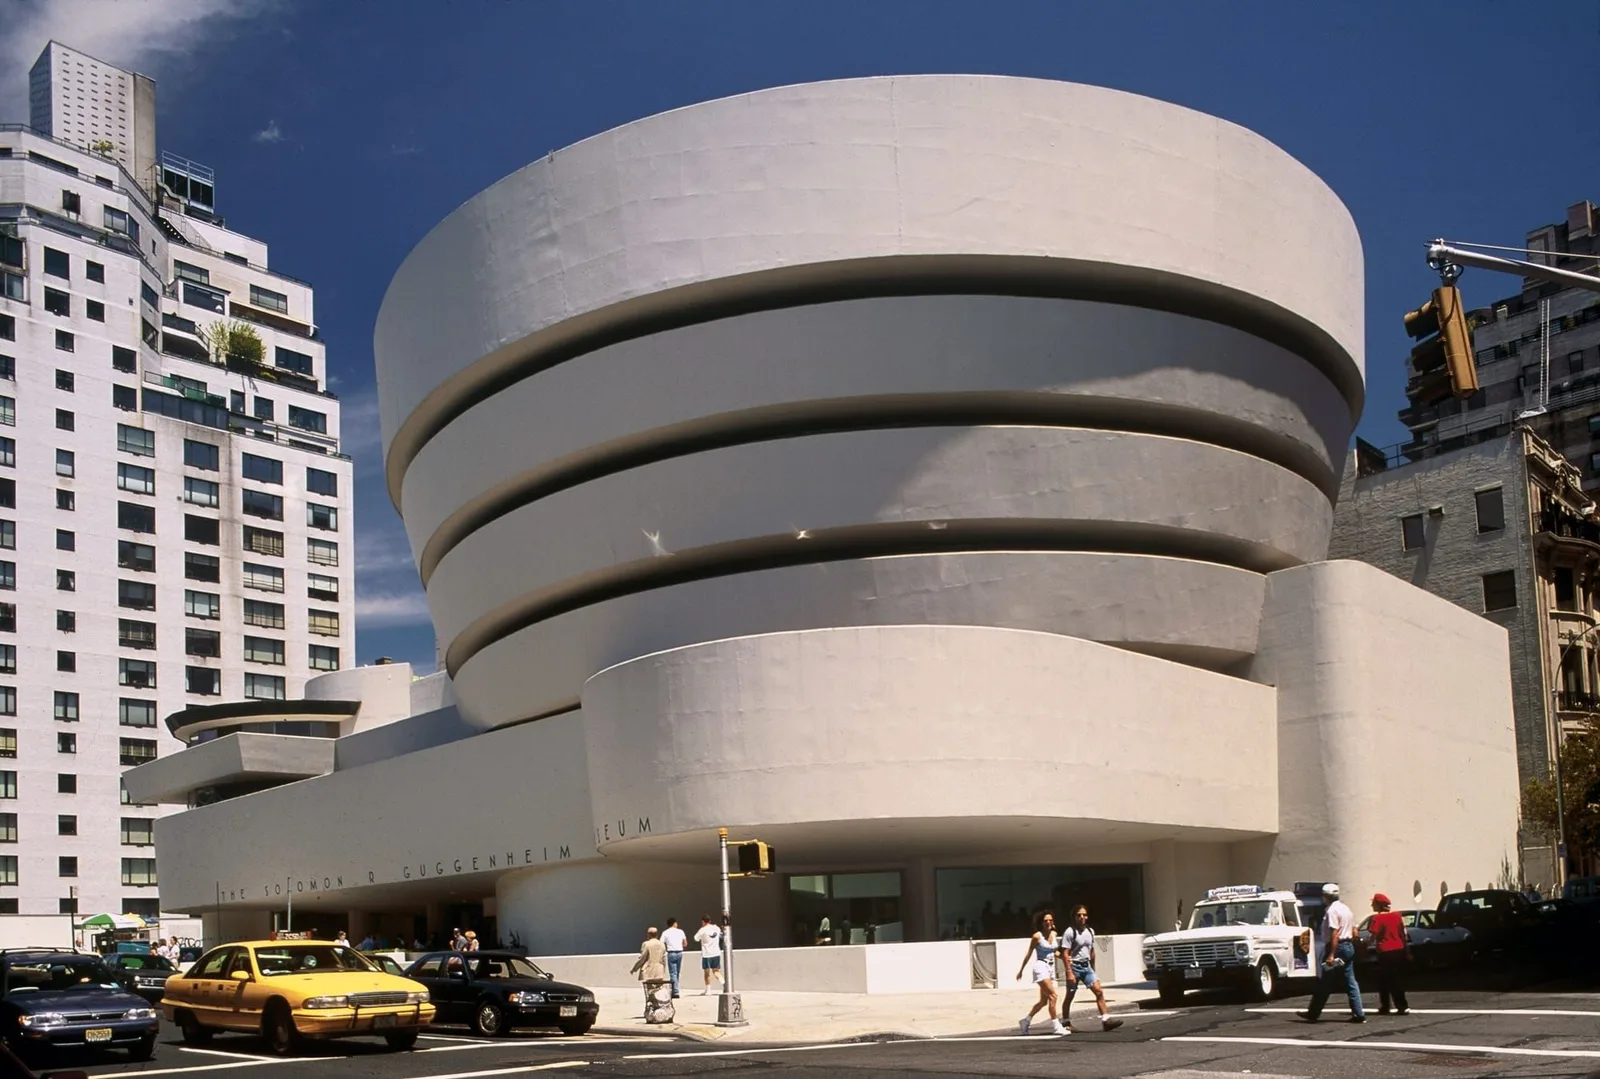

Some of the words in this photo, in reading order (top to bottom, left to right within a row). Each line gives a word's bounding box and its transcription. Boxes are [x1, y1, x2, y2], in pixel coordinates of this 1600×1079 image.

[221, 888, 245, 901] THE
[368, 871, 375, 884] R
[403, 845, 571, 879] GUGGENHEIM
